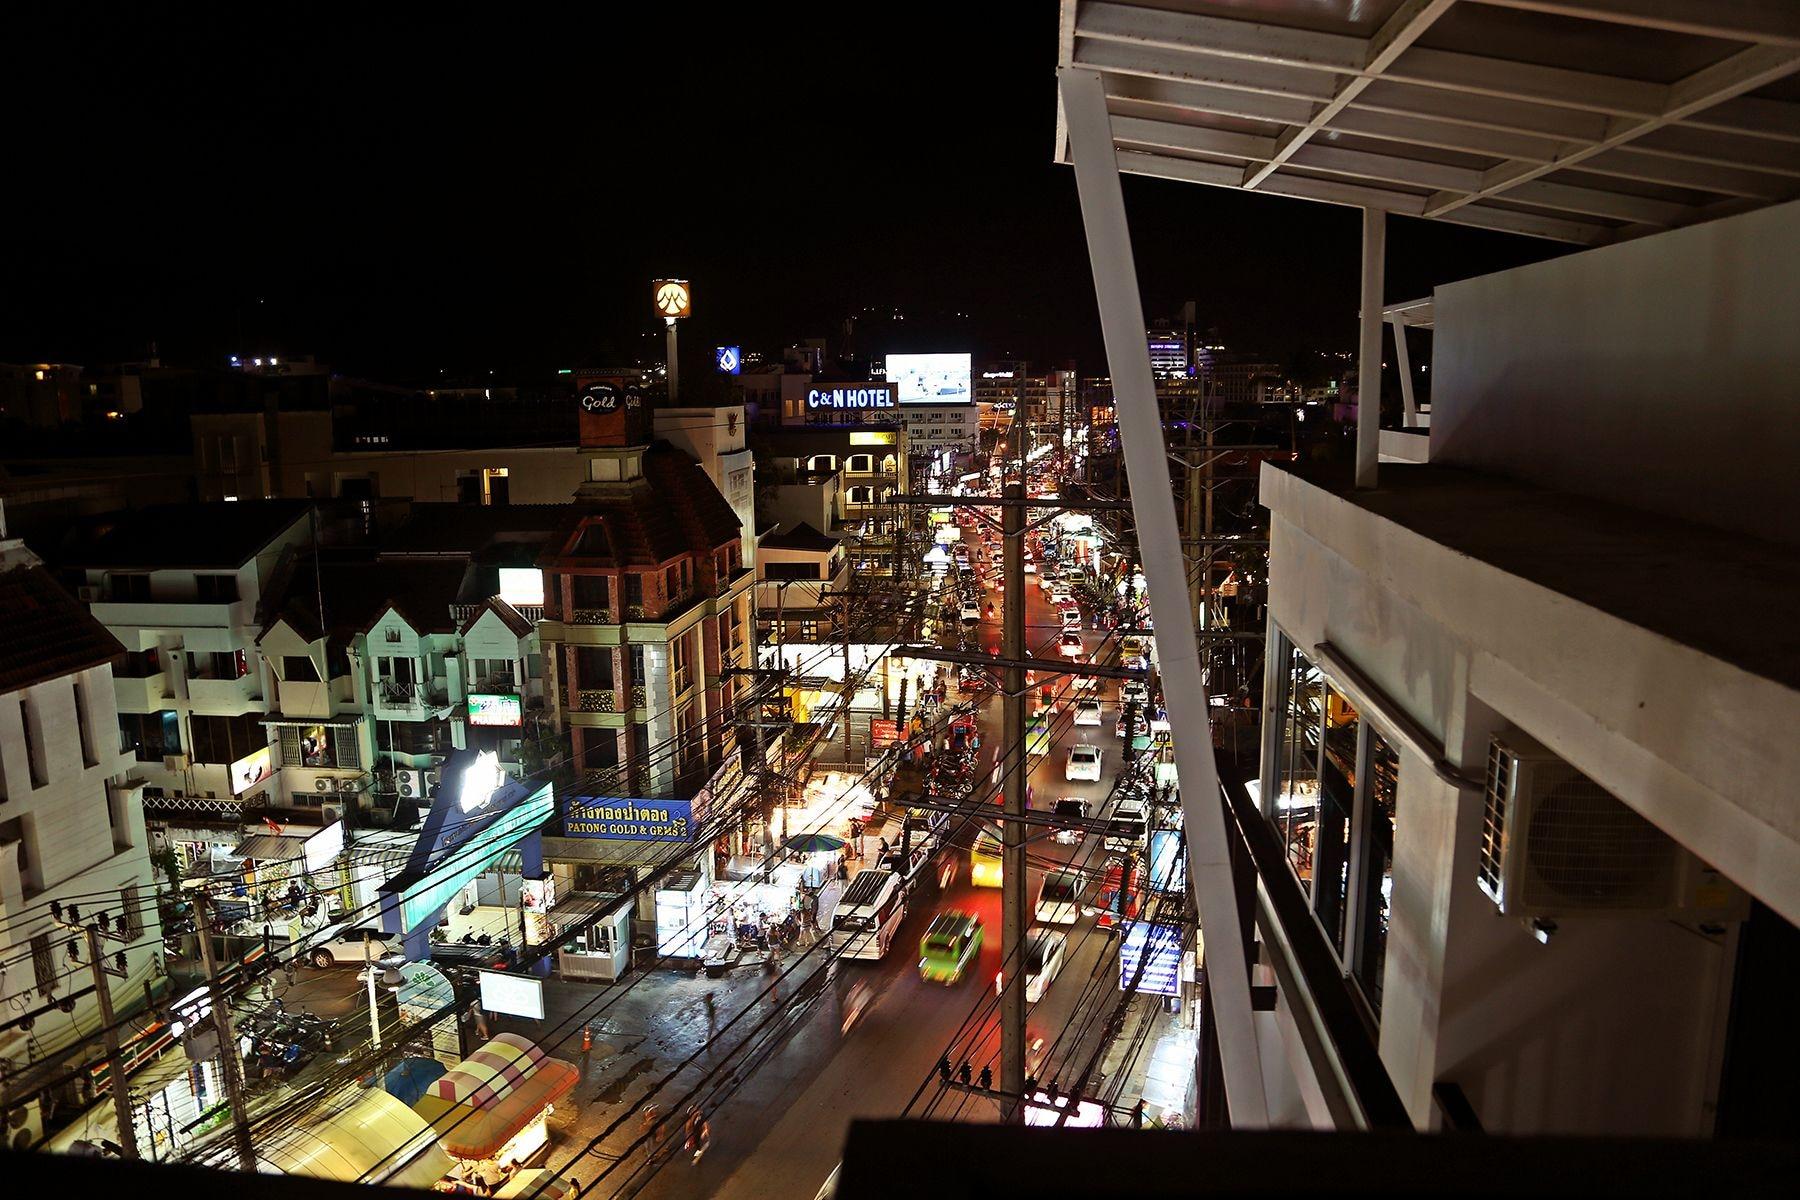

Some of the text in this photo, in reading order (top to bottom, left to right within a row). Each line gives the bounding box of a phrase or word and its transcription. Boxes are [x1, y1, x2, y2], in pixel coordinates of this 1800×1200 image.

[582, 395, 617, 411] Gold
[808, 389, 895, 408] C&N HOTEL
[567, 822, 688, 837] PATONG GOLD & GEMS 2
